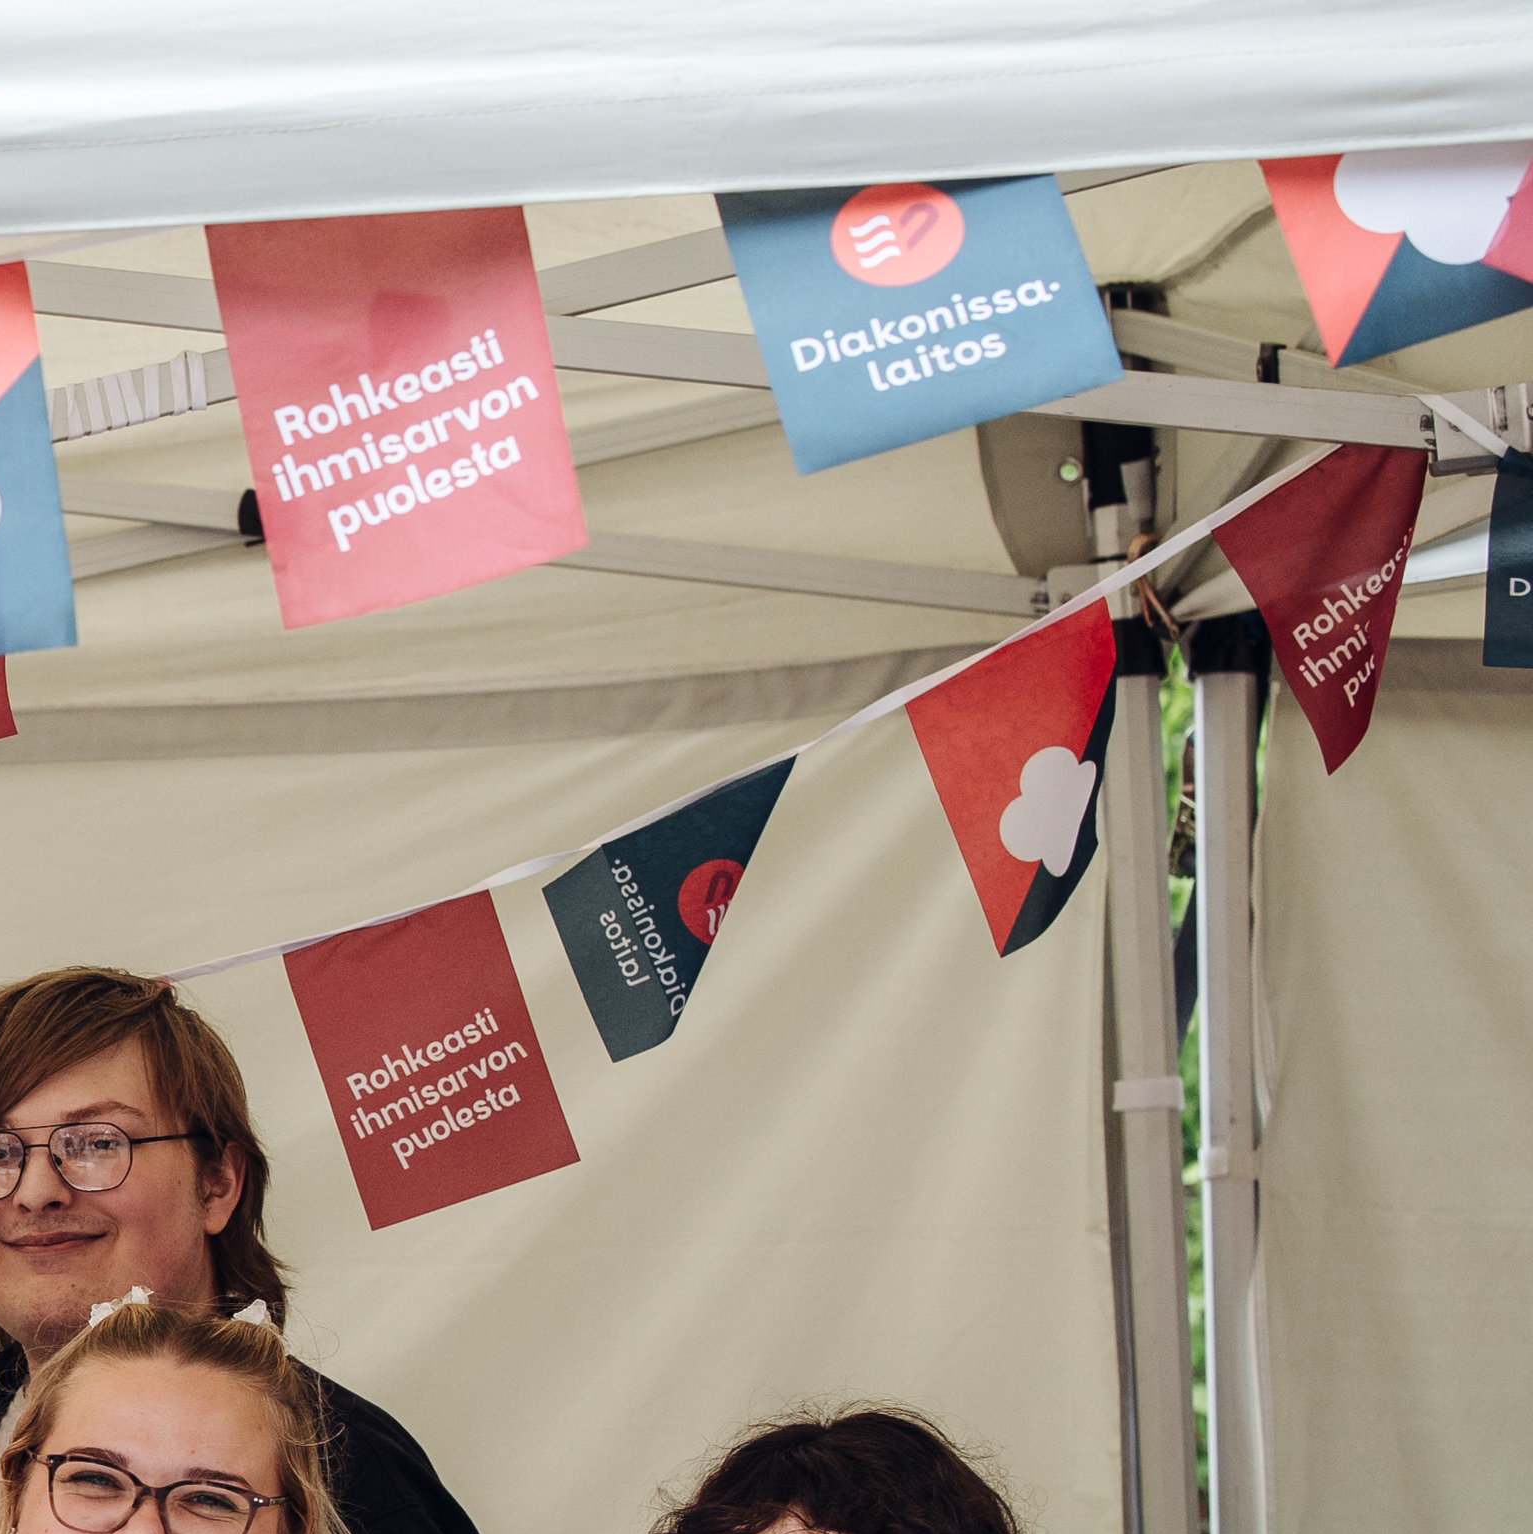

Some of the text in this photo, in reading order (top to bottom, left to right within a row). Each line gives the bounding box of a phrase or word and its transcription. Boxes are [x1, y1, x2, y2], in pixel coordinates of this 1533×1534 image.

[274, 328, 505, 446] Rohkeasti
[867, 331, 1007, 391] laitos
[272, 372, 539, 502] ihmisarvon
[327, 433, 522, 553] puolesta
[346, 1007, 498, 1100] Rohkeasti
[350, 1037, 528, 1139] ihmisarvon
[392, 1081, 521, 1170] puolesta
